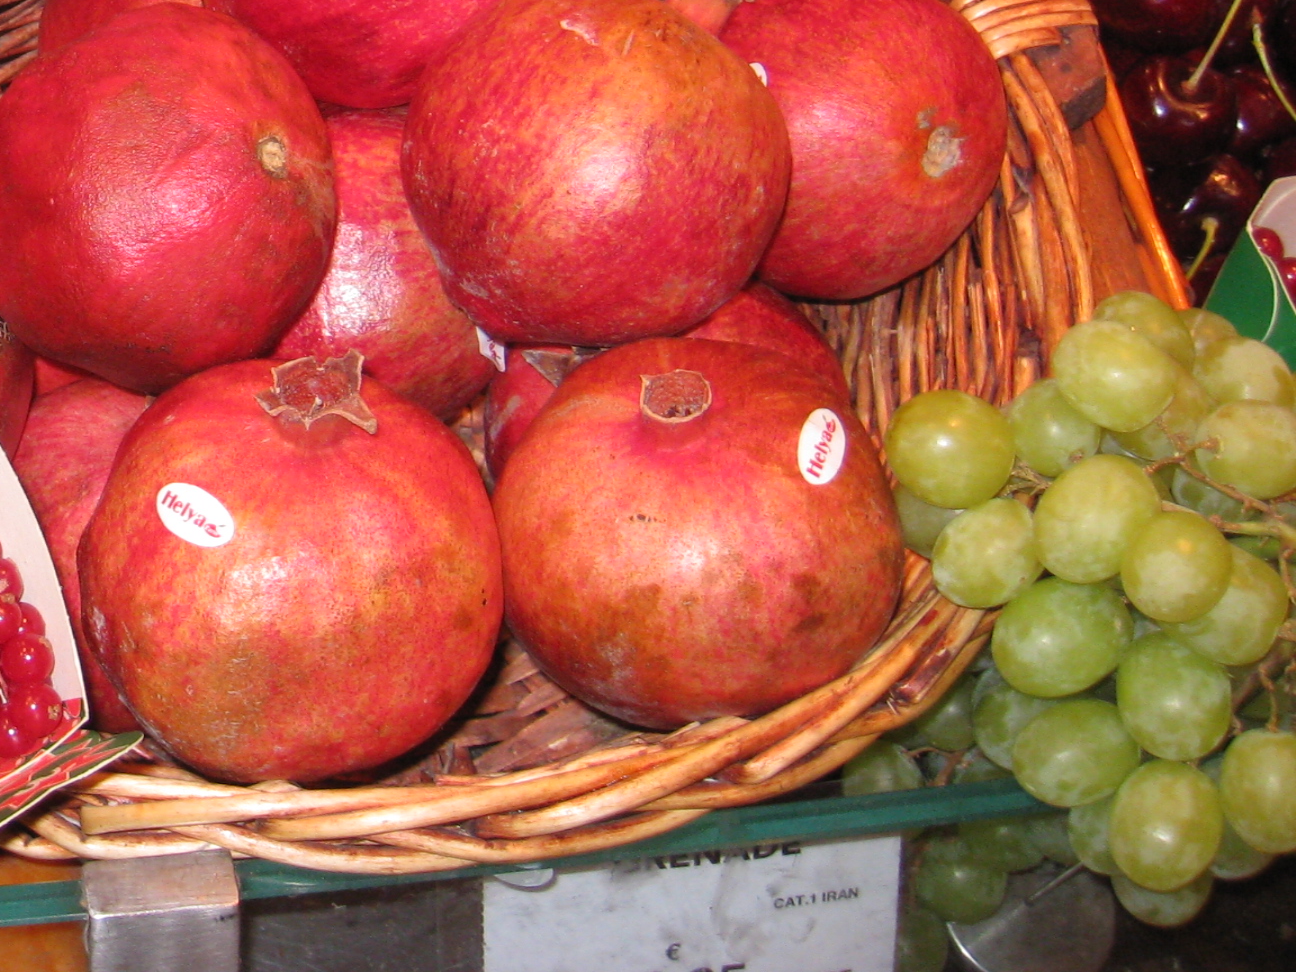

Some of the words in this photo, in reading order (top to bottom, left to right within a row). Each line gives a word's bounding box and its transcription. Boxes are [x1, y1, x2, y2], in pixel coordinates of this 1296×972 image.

[773, 893, 817, 910] CAT.1
[821, 886, 860, 904] IRAN
[665, 942, 682, 961] €
